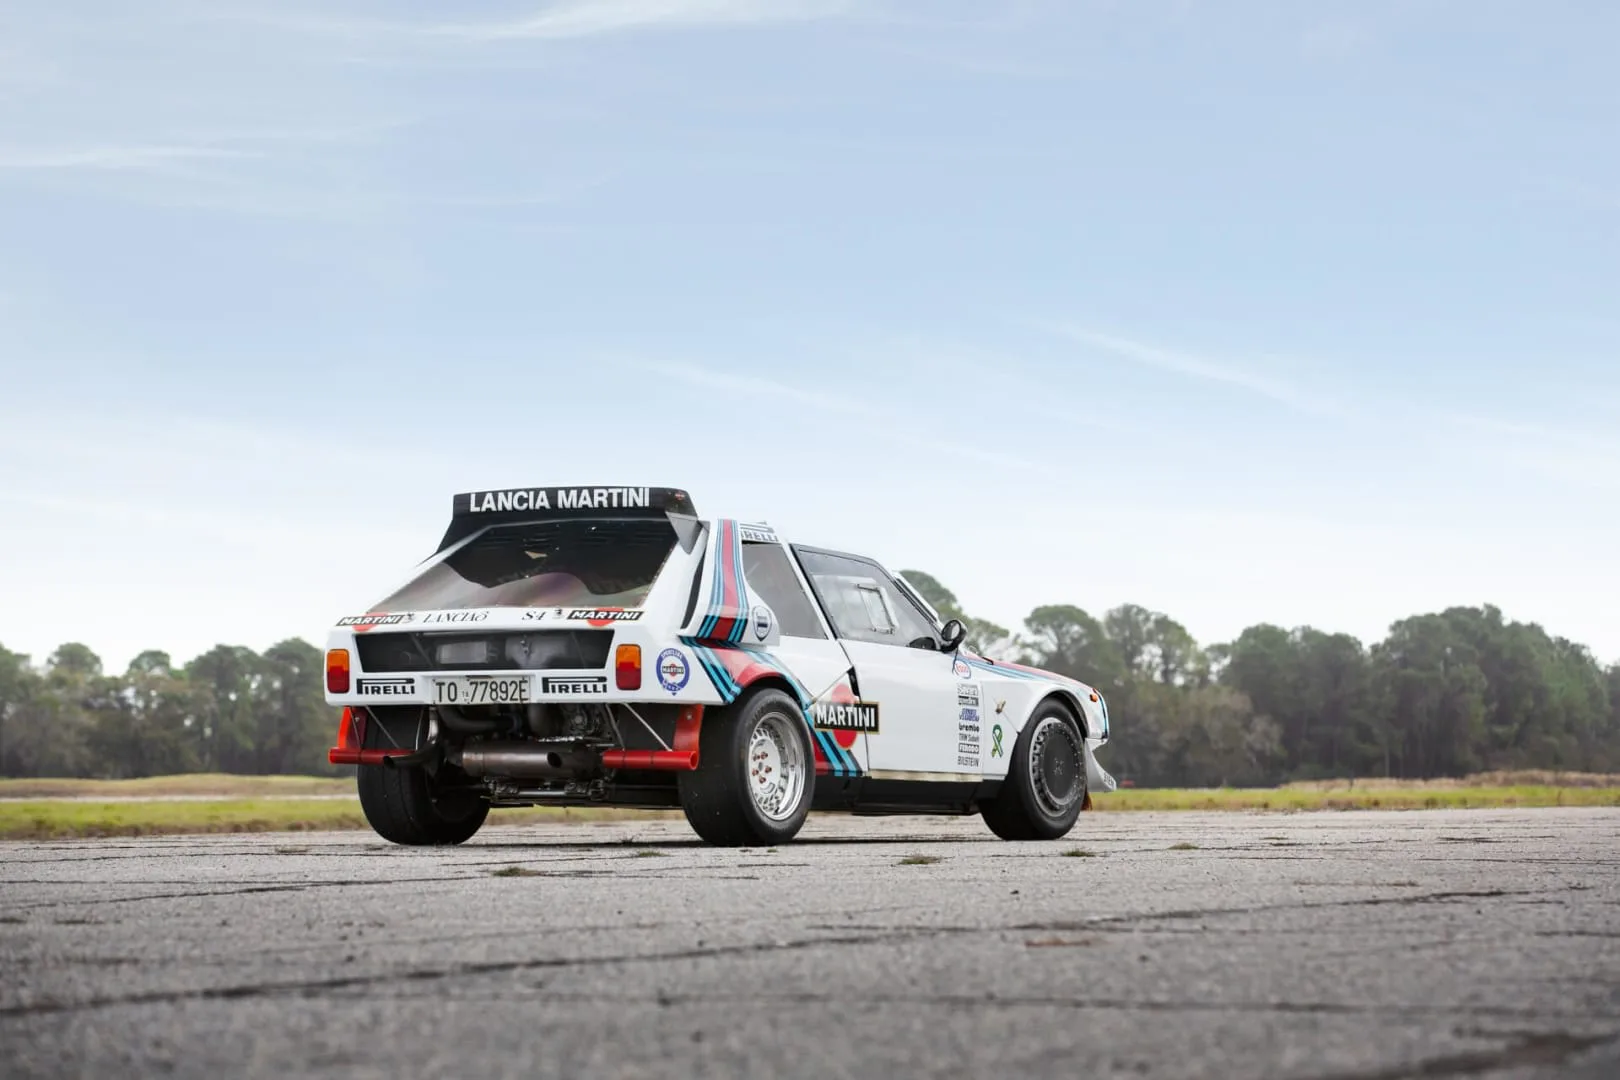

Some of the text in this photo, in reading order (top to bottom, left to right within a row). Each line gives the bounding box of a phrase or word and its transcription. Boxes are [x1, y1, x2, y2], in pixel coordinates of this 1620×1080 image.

[469, 487, 650, 513] LANCIA MARTINI
[340, 615, 403, 625] MARTINI
[522, 610, 547, 620] S4
[571, 611, 640, 620] MARTINI
[356, 678, 416, 695] PIRELLI
[435, 681, 458, 703] TO
[469, 680, 529, 703] 77892E
[542, 677, 608, 694] PIRELLI
[816, 704, 876, 728] MARTINI
[958, 722, 980, 732] brembo
